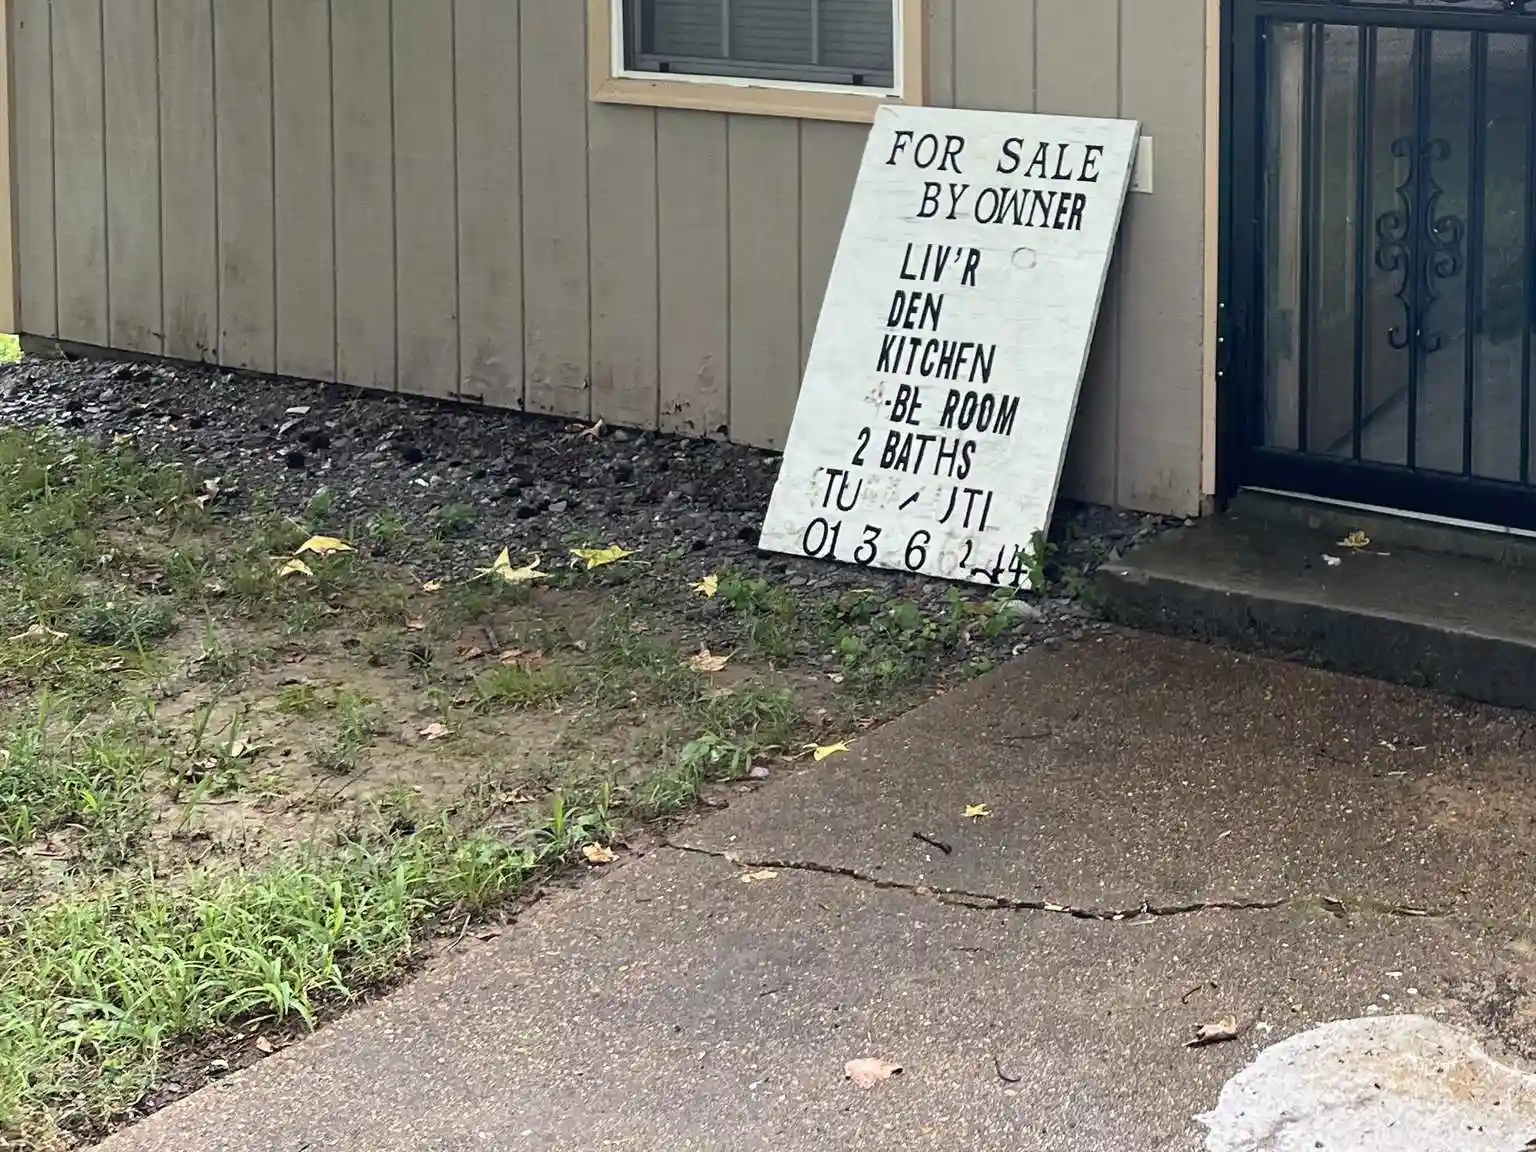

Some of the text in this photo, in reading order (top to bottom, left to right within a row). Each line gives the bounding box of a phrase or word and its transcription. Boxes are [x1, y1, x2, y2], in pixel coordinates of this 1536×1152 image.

[885, 130, 1104, 183] FOR SALE
[916, 181, 1086, 231] BY OWNER
[886, 289, 944, 332] DEN
[939, 388, 1021, 436] ROOM
[851, 426, 977, 480] 2 BATHS
